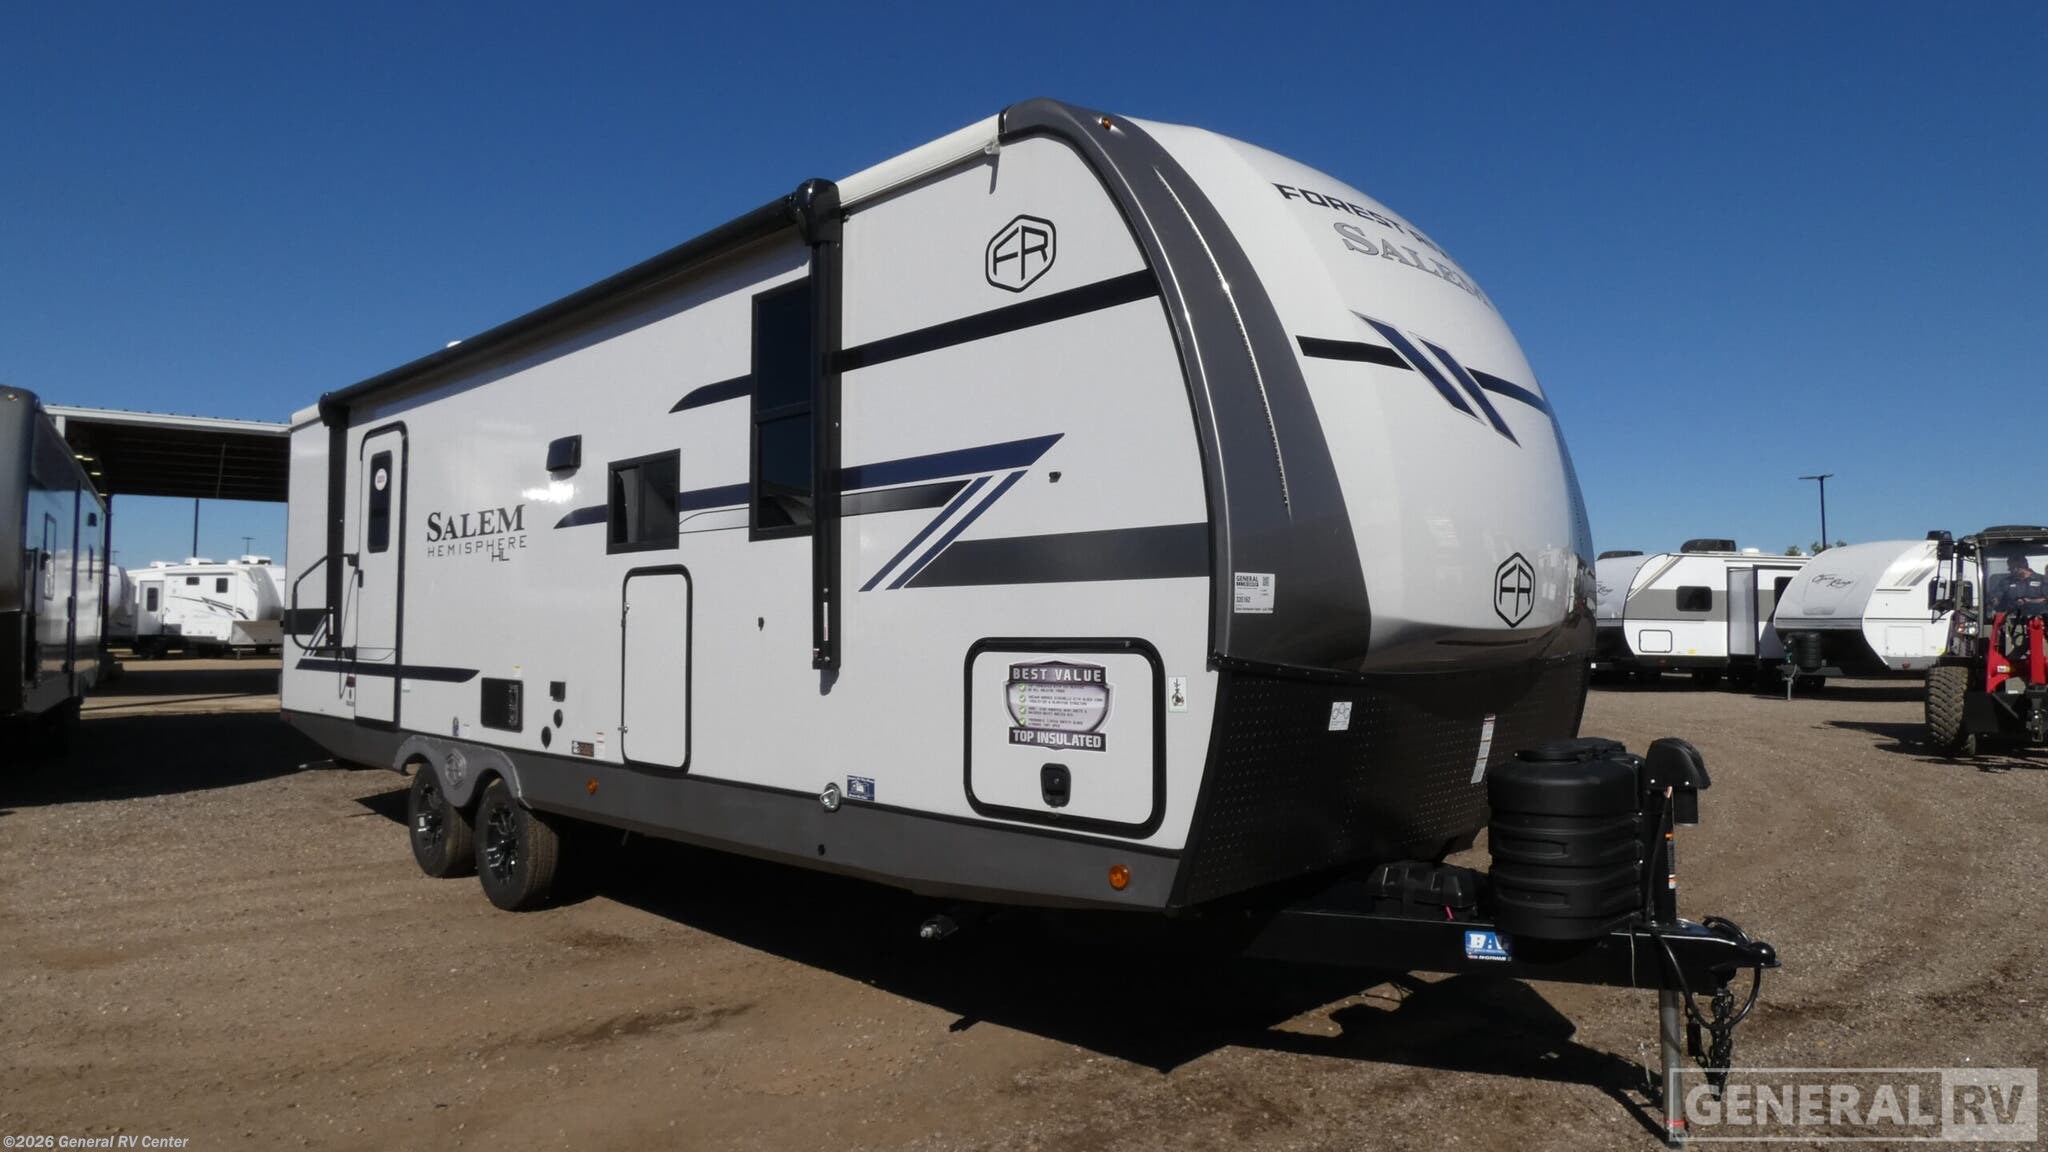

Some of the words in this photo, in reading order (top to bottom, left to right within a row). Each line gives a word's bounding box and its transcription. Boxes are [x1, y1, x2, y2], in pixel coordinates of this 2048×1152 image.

[1271, 183, 1405, 233] FOREST
[427, 504, 525, 542] SALEM
[427, 535, 527, 557] HEMISPHERE
[1013, 668, 1047, 679] BEST
[1055, 669, 1102, 682] VALUE
[1013, 730, 1034, 742] TOP
[1037, 732, 1102, 748] INSULATED
